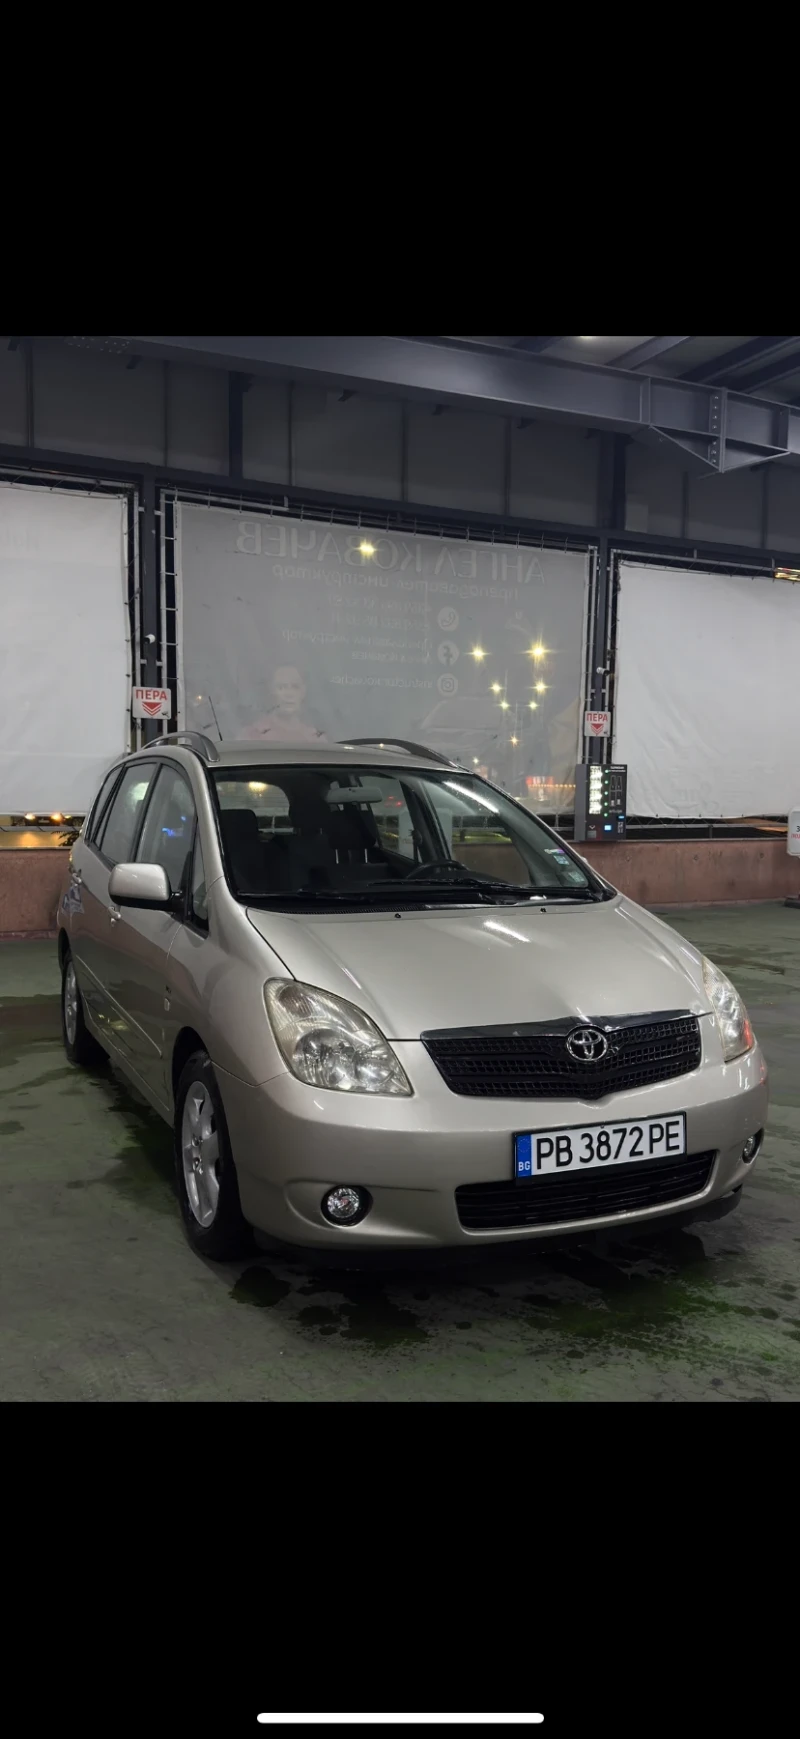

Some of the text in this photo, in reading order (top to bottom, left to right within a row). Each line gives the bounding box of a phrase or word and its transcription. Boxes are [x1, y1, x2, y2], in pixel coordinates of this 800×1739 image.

[135, 689, 167, 701] ПЕРА
[586, 712, 608, 722] ПЕРА
[536, 1120, 680, 1170] PB 3872 PE
[518, 1161, 530, 1171] BG
